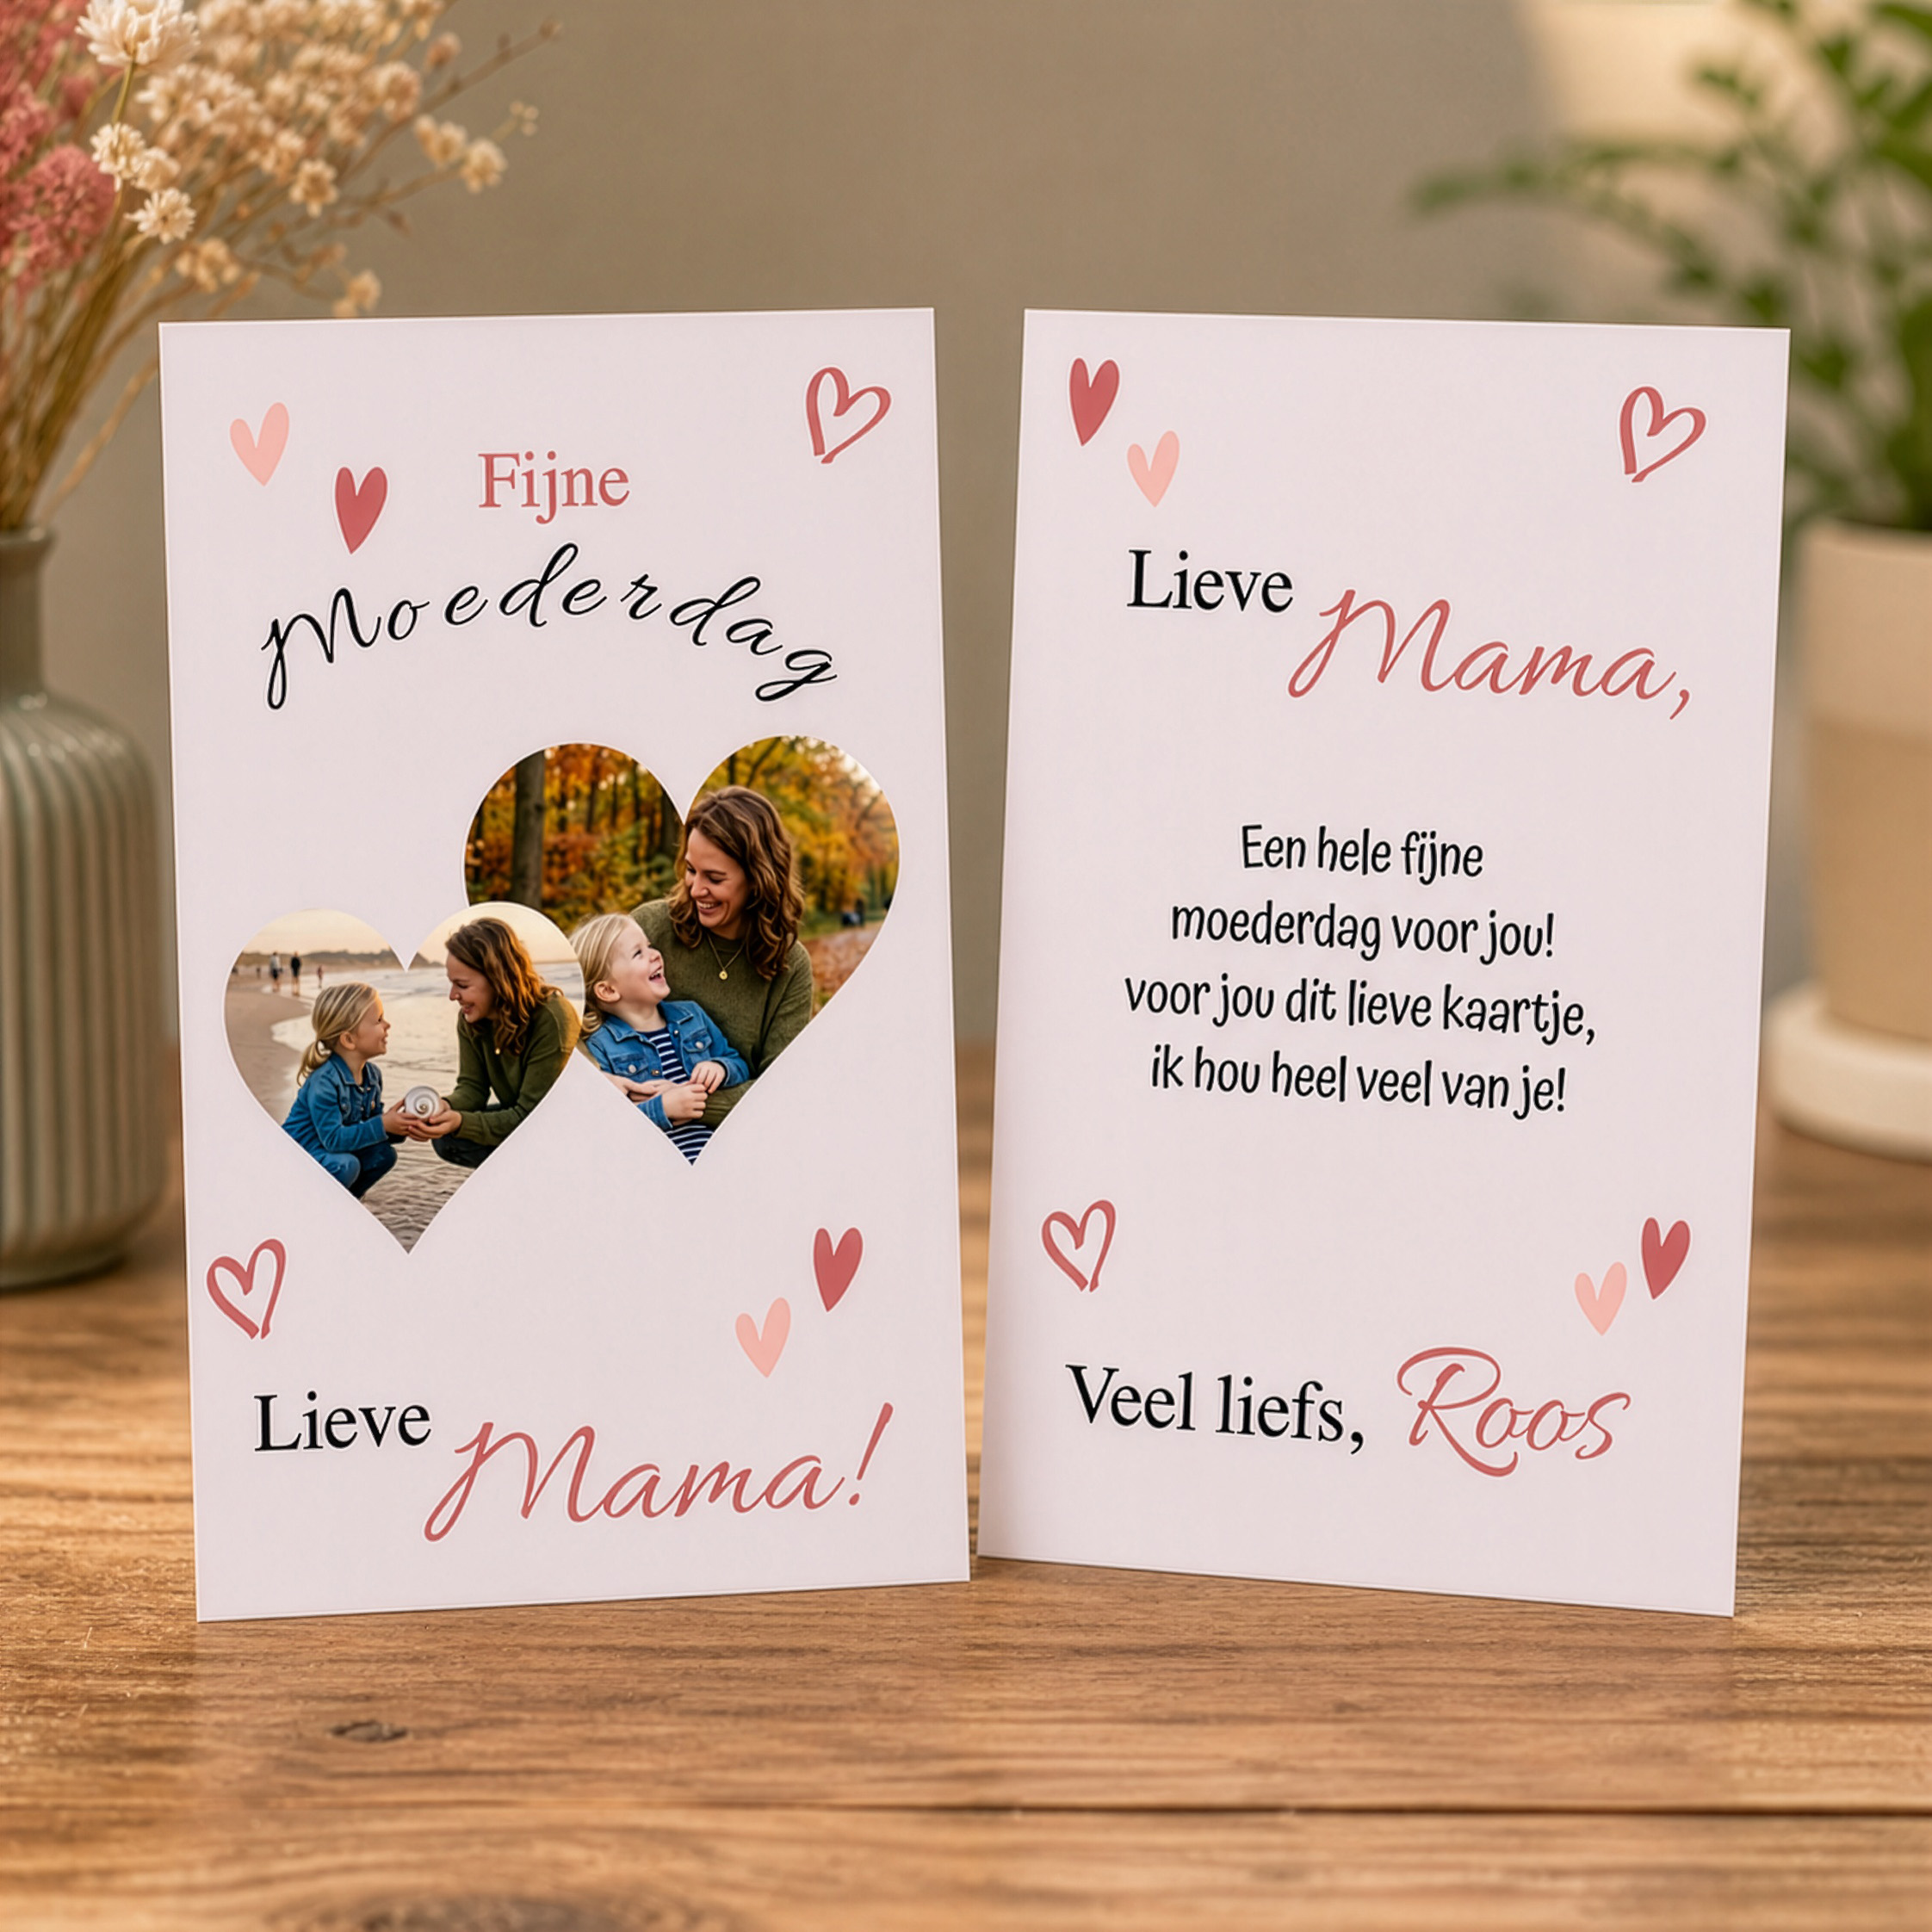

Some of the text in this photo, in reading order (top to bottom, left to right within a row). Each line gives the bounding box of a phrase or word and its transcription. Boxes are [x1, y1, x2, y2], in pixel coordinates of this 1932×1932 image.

[478, 450, 630, 524] Fijne
[260, 542, 839, 710] Moederdag
[1126, 548, 1690, 721] Lieve Mama,
[1242, 824, 1483, 886] Een hele fijne
[1172, 899, 1555, 966] moederdag voor jou!
[1124, 972, 1595, 1046] voor jou dit lieve kaartje,
[1151, 1043, 1566, 1121] ik hou heel veel van je!
[1064, 1347, 1632, 1477] Veel liefs, Roos
[253, 1390, 894, 1542] Lieve Mama!
